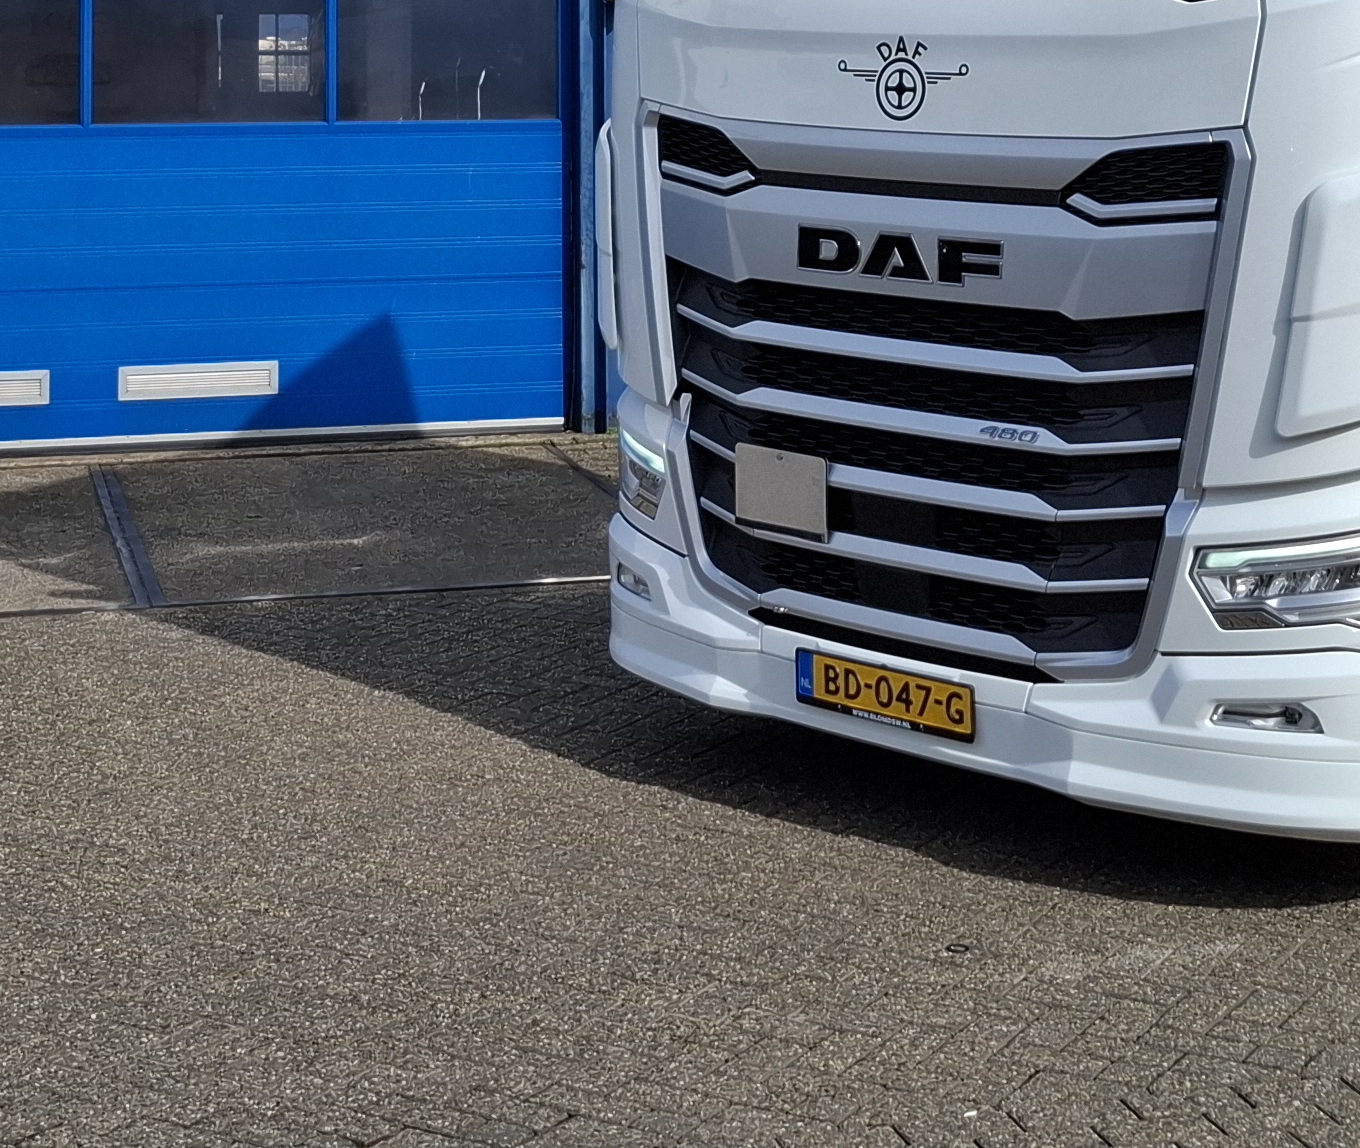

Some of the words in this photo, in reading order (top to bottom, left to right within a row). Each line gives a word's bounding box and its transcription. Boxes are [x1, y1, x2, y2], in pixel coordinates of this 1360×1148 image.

[875, 35, 929, 63] DAF
[797, 222, 1004, 287] DAF
[979, 425, 1040, 444] 480
[800, 676, 812, 689] NL
[823, 663, 965, 726] BD-047-G
